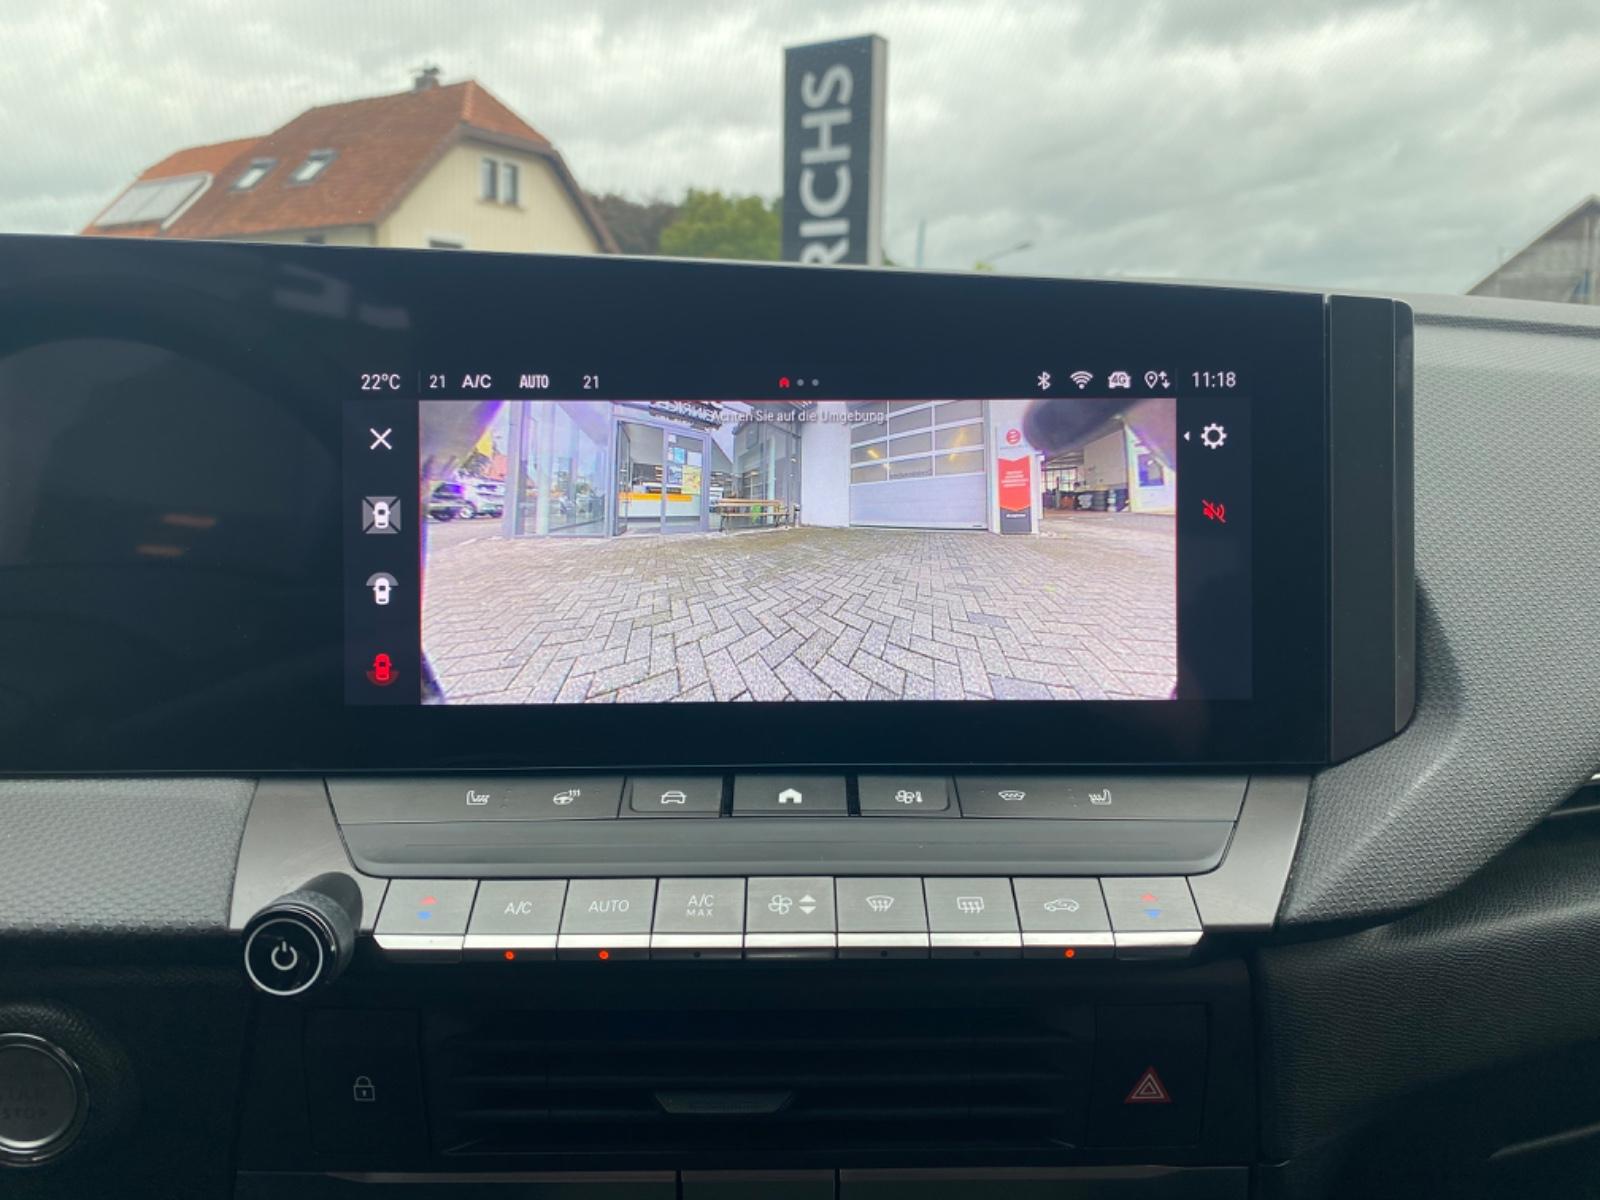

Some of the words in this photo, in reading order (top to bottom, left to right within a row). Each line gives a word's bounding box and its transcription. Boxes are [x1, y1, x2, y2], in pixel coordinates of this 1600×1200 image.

[360, 373, 401, 390] 22°C
[429, 374, 446, 389] 21
[461, 373, 492, 389] A/C
[519, 373, 550, 389] AUTO
[583, 374, 600, 389] 21
[1191, 371, 1237, 388] 11:18
[757, 409, 774, 422] Sie
[777, 409, 797, 422] auf
[798, 409, 817, 422] die
[504, 901, 533, 916] A/C
[588, 899, 630, 914] AUTO
[687, 894, 715, 908] A/C
[686, 908, 713, 918] MAX
